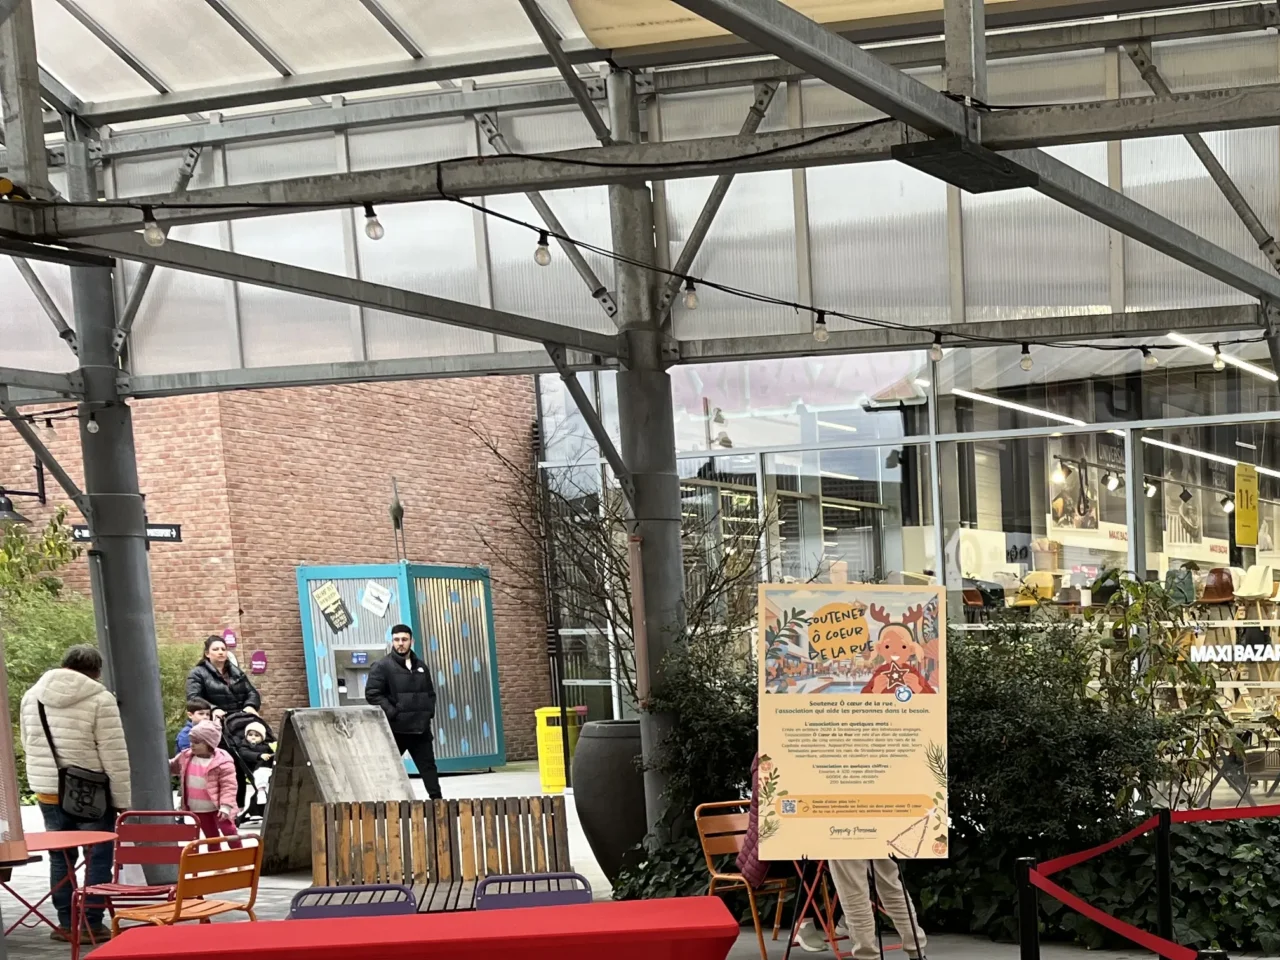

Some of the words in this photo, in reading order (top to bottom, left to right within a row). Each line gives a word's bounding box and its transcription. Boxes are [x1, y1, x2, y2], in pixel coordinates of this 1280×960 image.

[804, 608, 865, 626] SOUTENEZ
[812, 630, 821, 643] Ô
[826, 627, 863, 640] COEUR
[809, 649, 827, 660] DE
[831, 646, 846, 658] LA
[850, 640, 874, 654] RUE
[1190, 645, 1233, 662] MAXI
